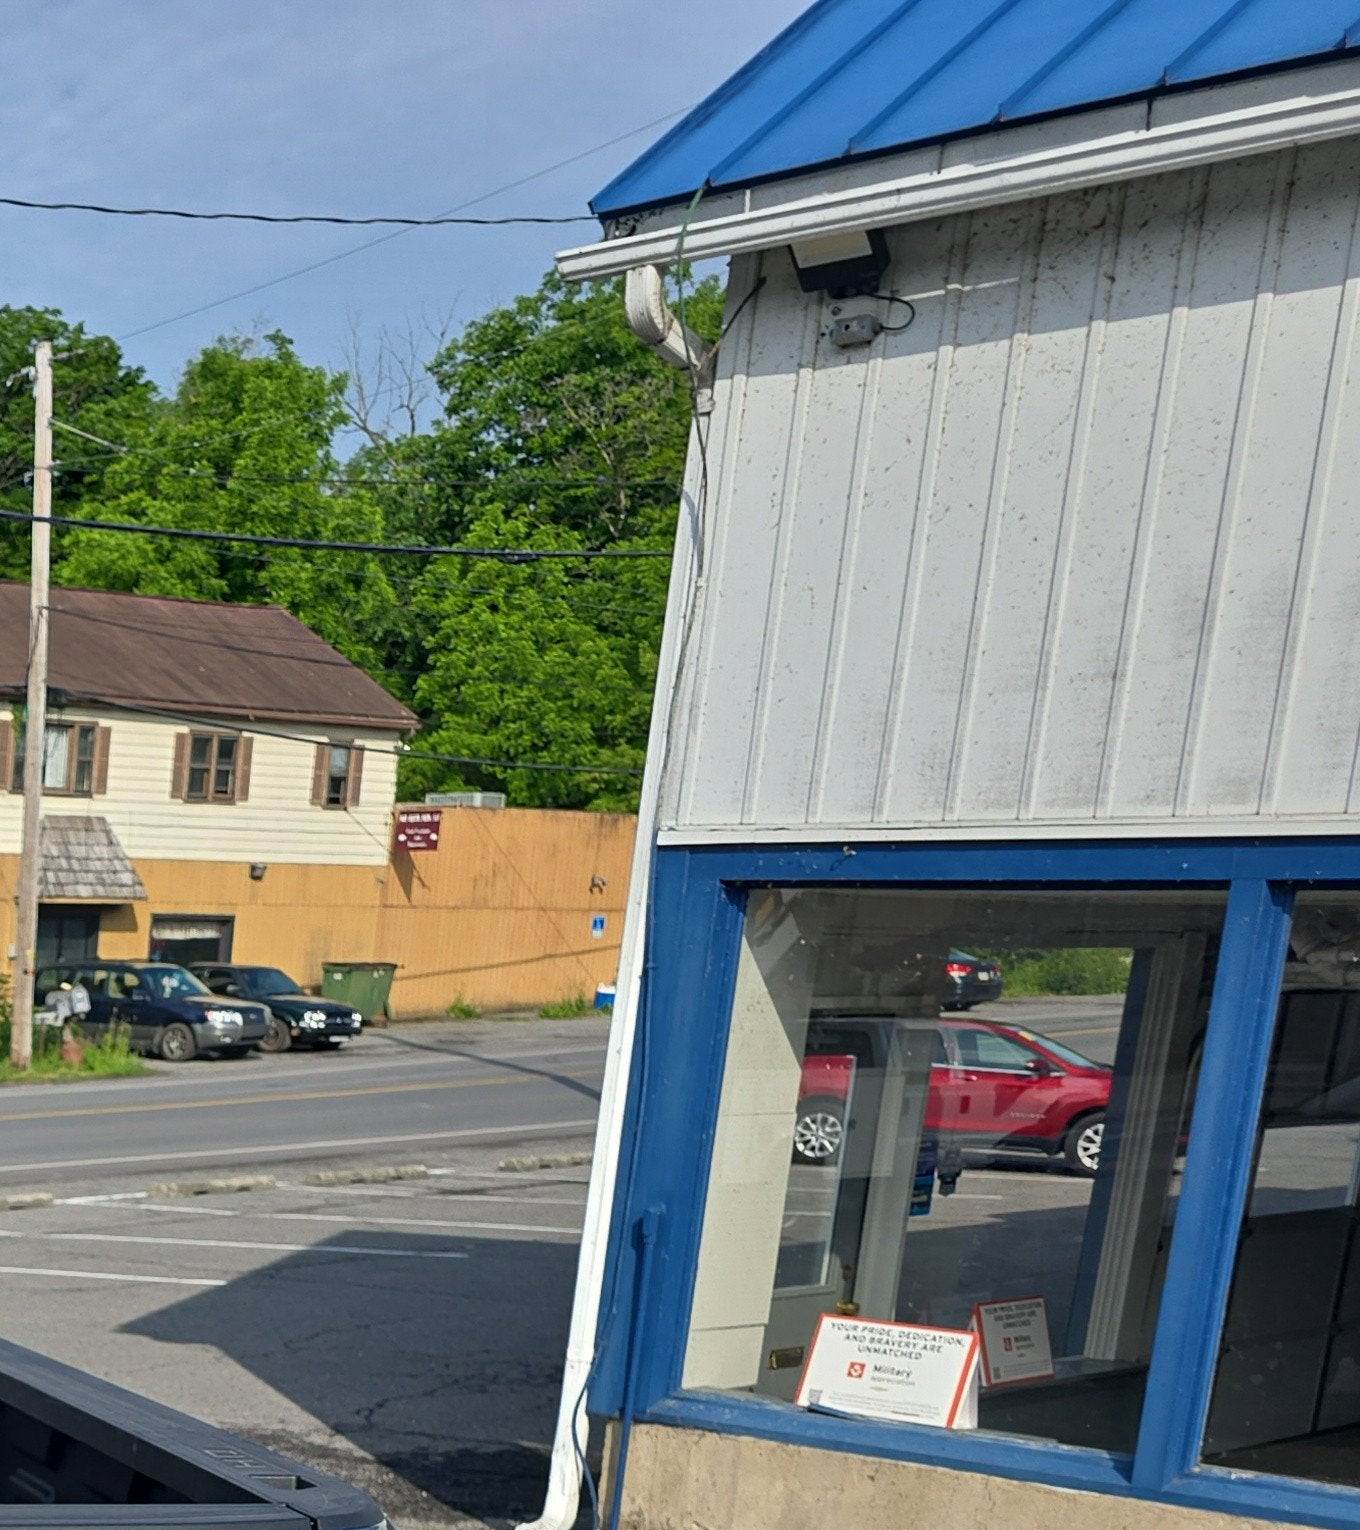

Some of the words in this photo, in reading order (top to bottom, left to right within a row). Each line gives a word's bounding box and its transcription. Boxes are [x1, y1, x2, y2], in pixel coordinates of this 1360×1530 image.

[831, 1322, 860, 1333] YOUR
[844, 1333, 867, 1343] AND
[869, 1338, 919, 1350] BRAVERY
[922, 1344, 944, 1353] ARE
[857, 1345, 923, 1360] UNMATCHED
[872, 1364, 912, 1378] Military
